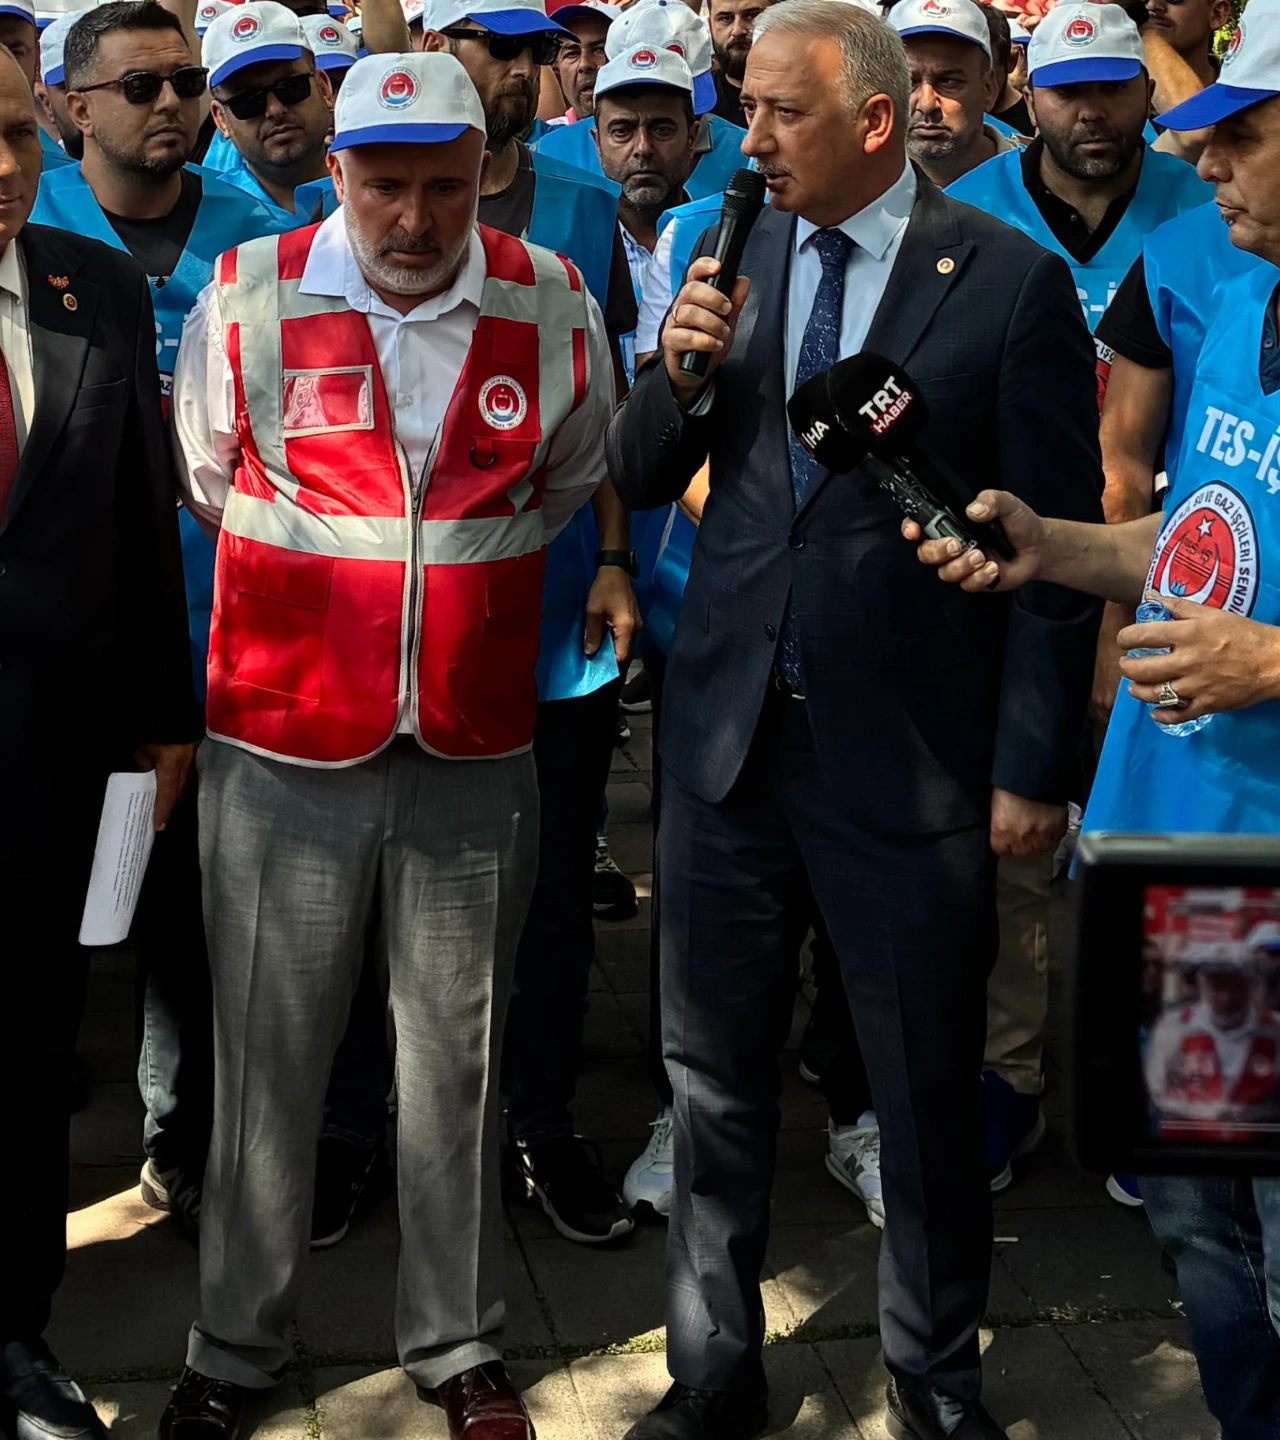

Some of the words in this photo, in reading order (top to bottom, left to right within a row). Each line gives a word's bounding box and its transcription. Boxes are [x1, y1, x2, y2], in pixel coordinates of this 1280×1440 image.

[858, 375, 902, 421] TRT
[872, 390, 913, 434] HABER
[1214, 492, 1234, 515] GAZ
